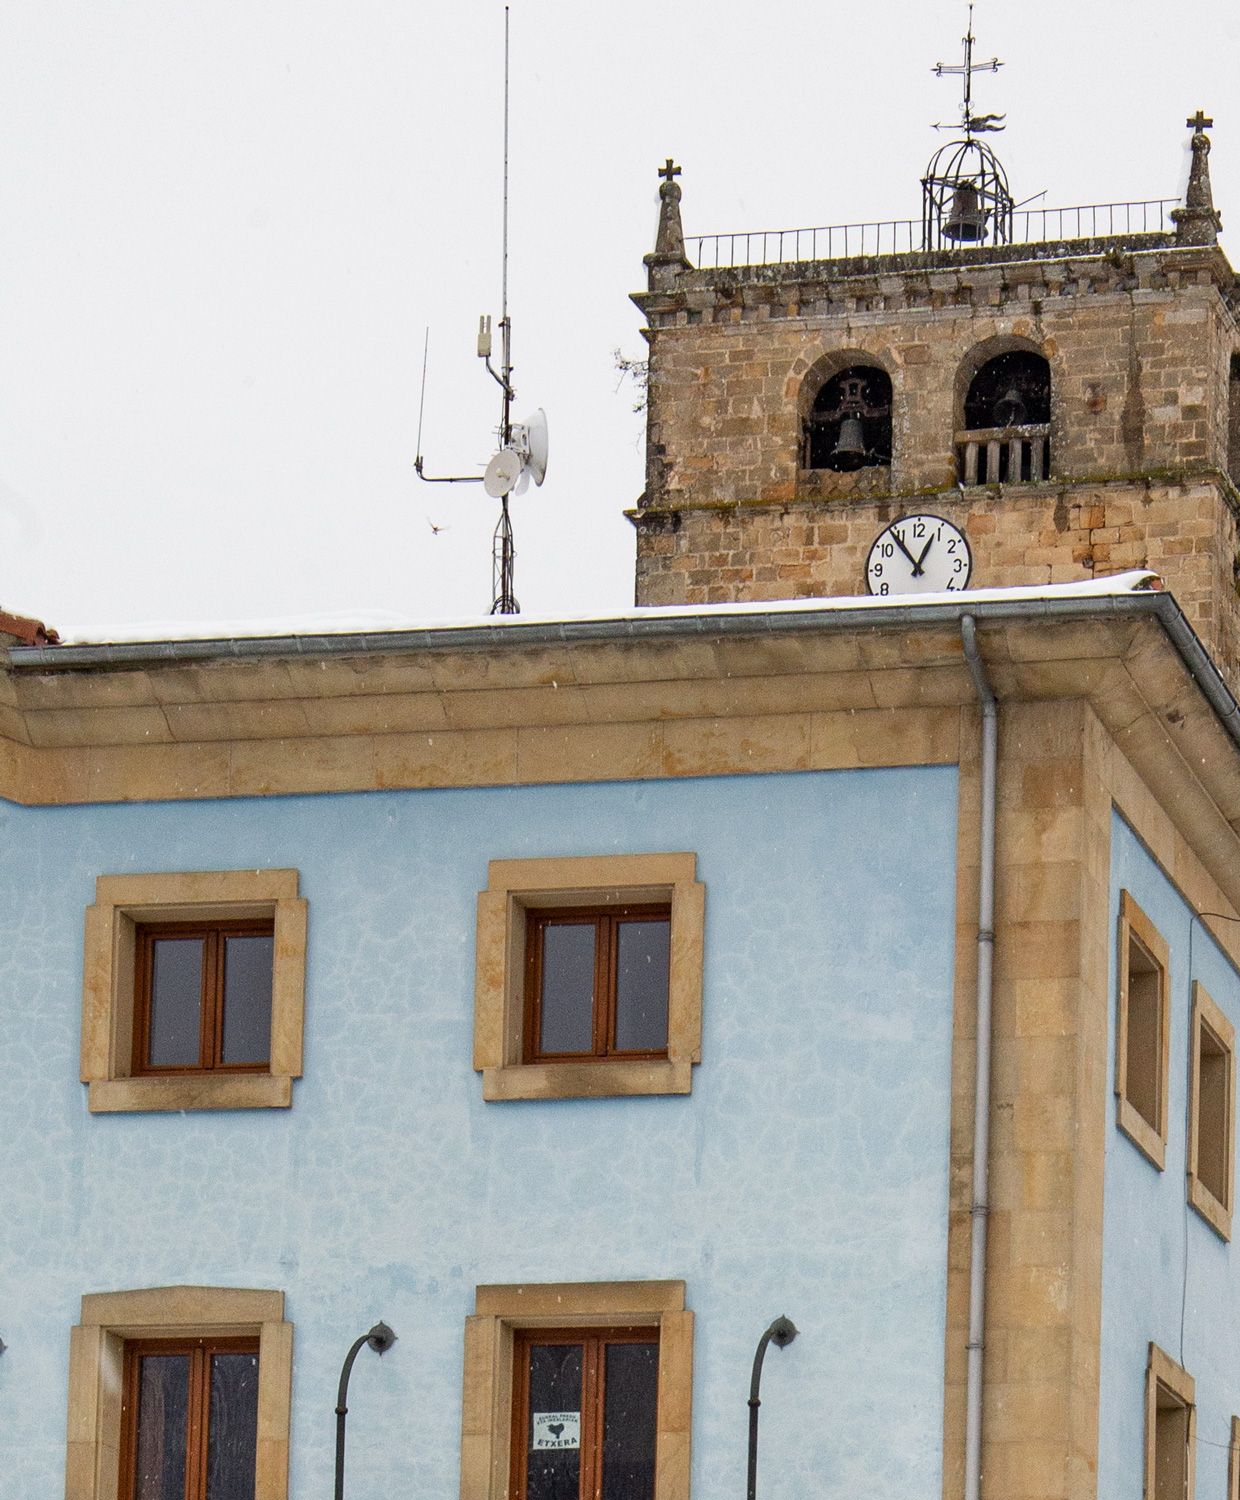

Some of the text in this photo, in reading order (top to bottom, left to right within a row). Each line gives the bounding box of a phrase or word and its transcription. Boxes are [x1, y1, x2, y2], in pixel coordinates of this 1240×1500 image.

[913, 523, 926, 538] 12
[881, 543, 894, 558] 10
[947, 539, 956, 554] 2
[874, 563, 883, 577] 9
[953, 558, 962, 573] 3
[880, 582, 889, 596] 8
[946, 577, 955, 591] 4
[537, 1437, 578, 1448] ETXERA
